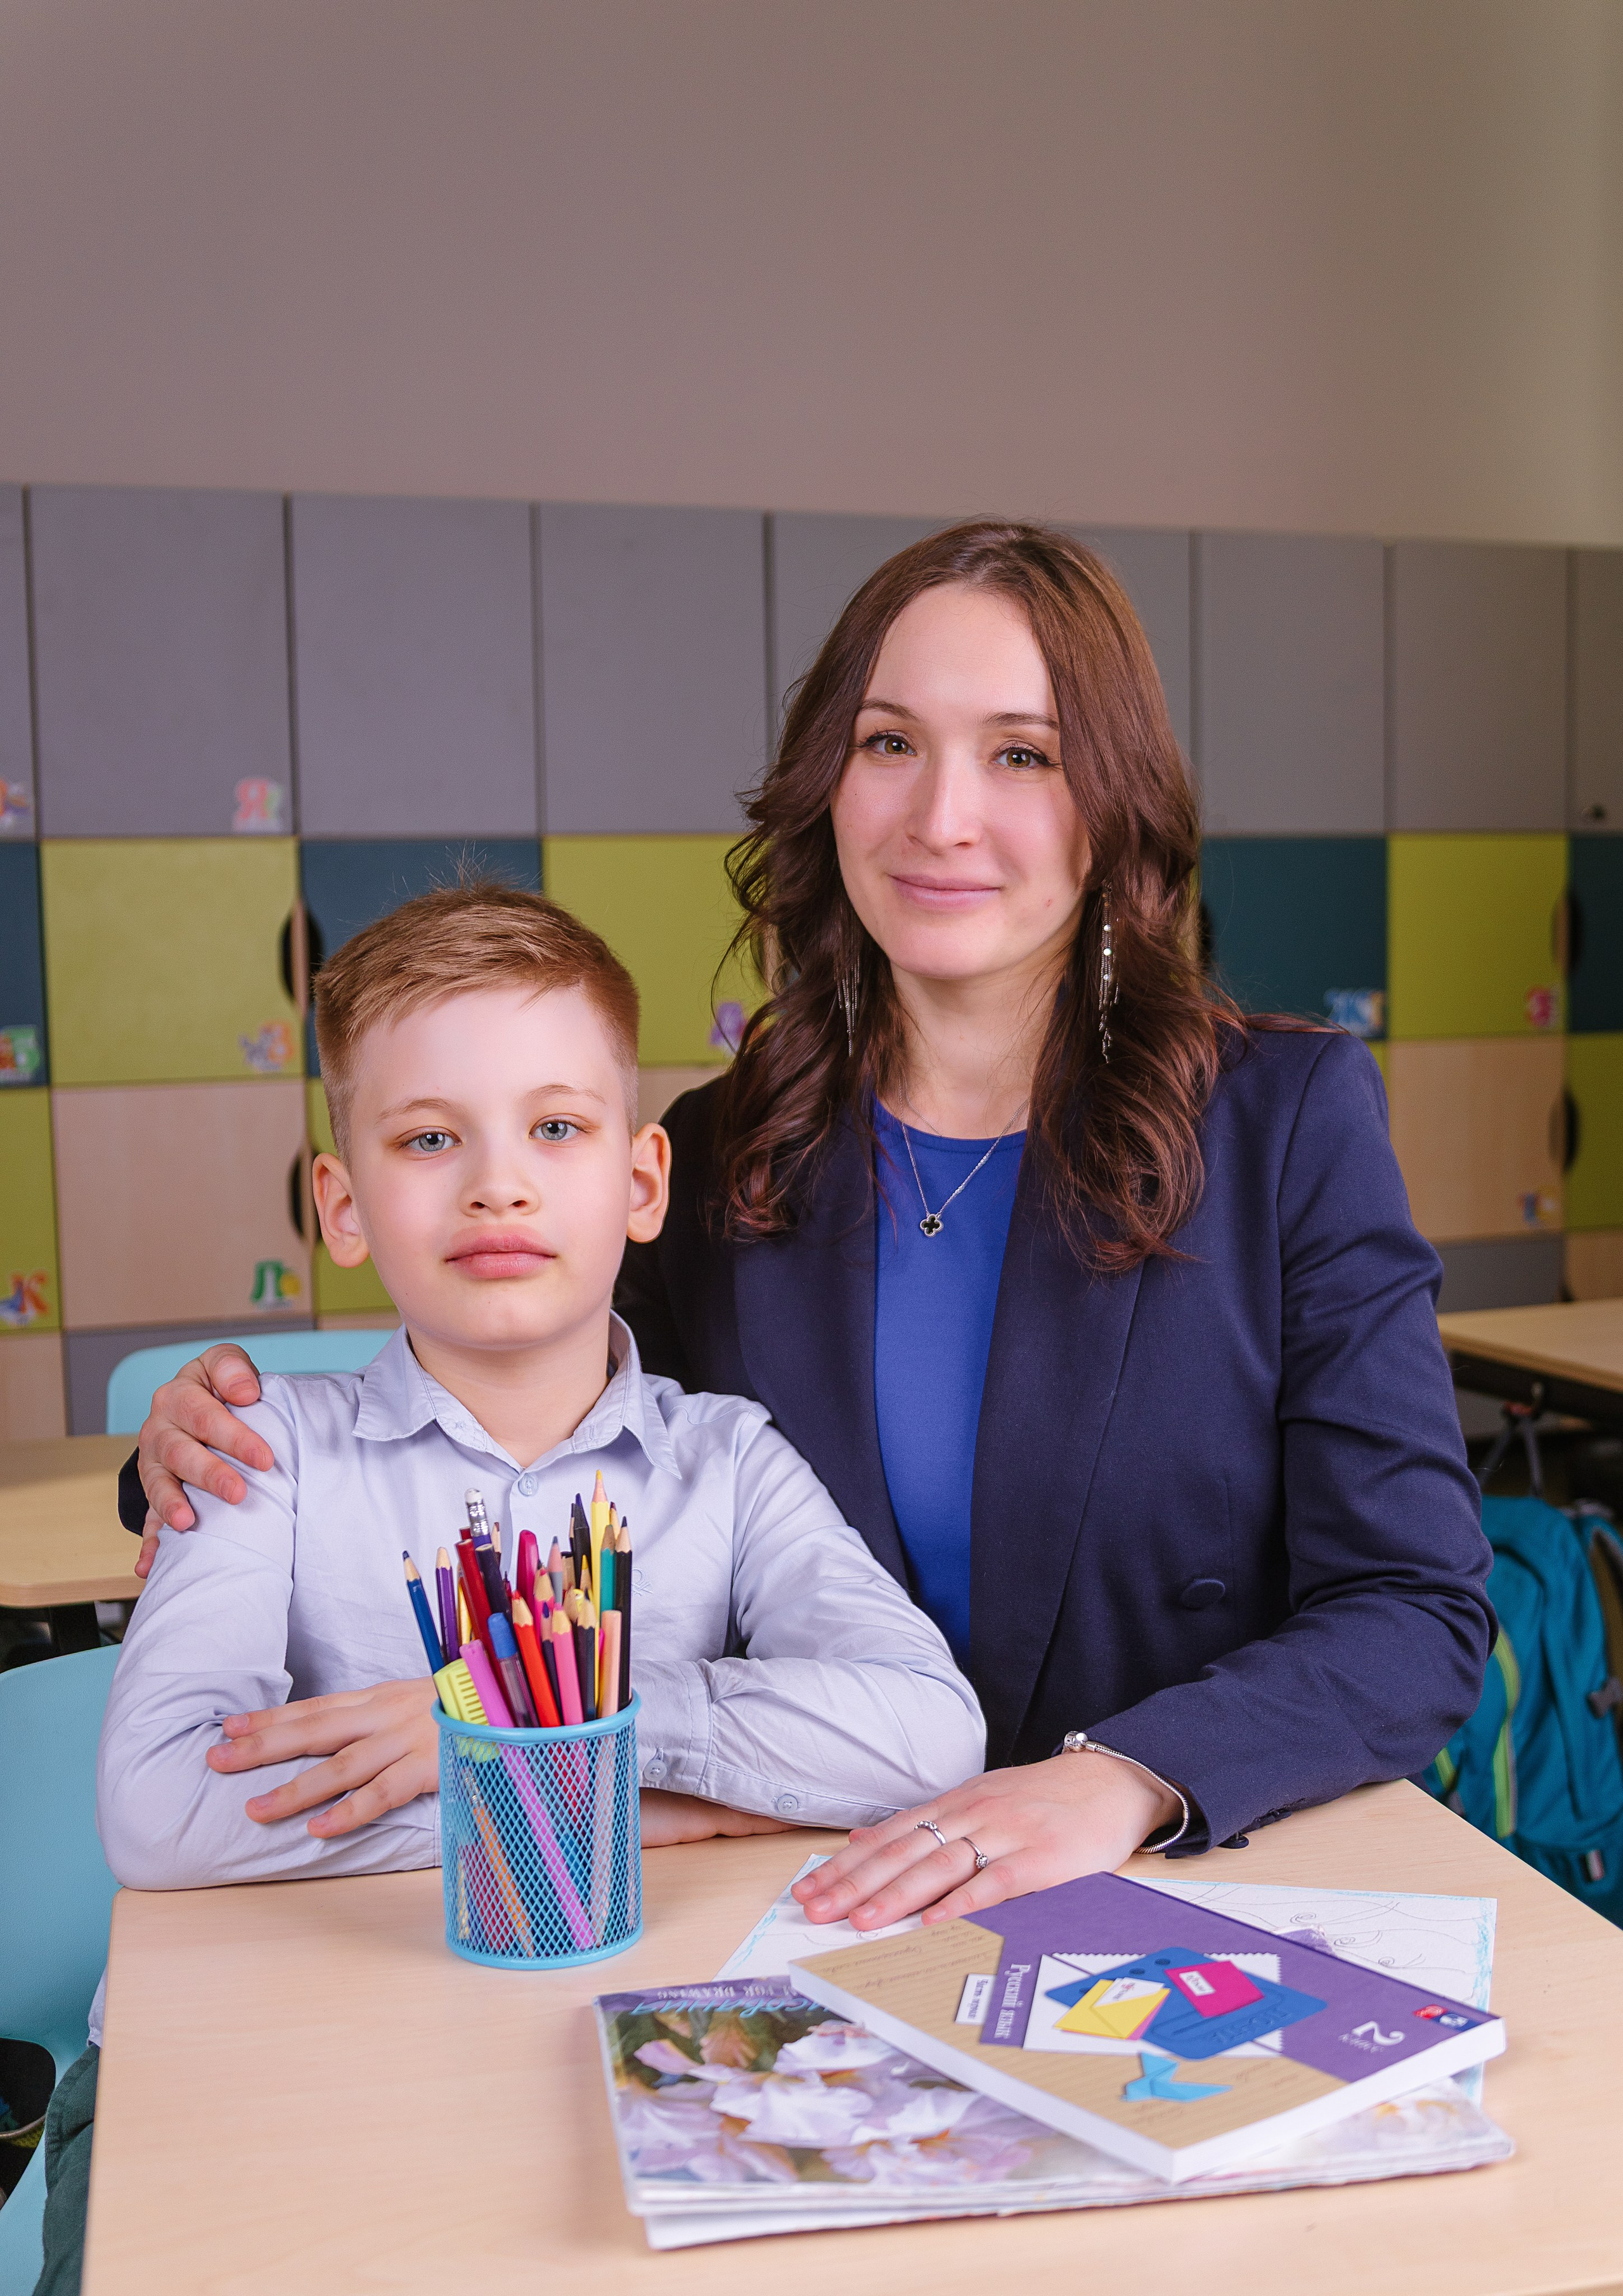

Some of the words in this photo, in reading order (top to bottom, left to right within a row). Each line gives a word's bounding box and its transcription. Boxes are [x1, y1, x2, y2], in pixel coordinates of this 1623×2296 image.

[657, 1985, 735, 2000] DRAWING
[742, 1984, 775, 1997] FOR
[1002, 1963, 1031, 2008] Русский
[993, 2008, 1016, 2039] язык
[1350, 2020, 1406, 2046] 2
